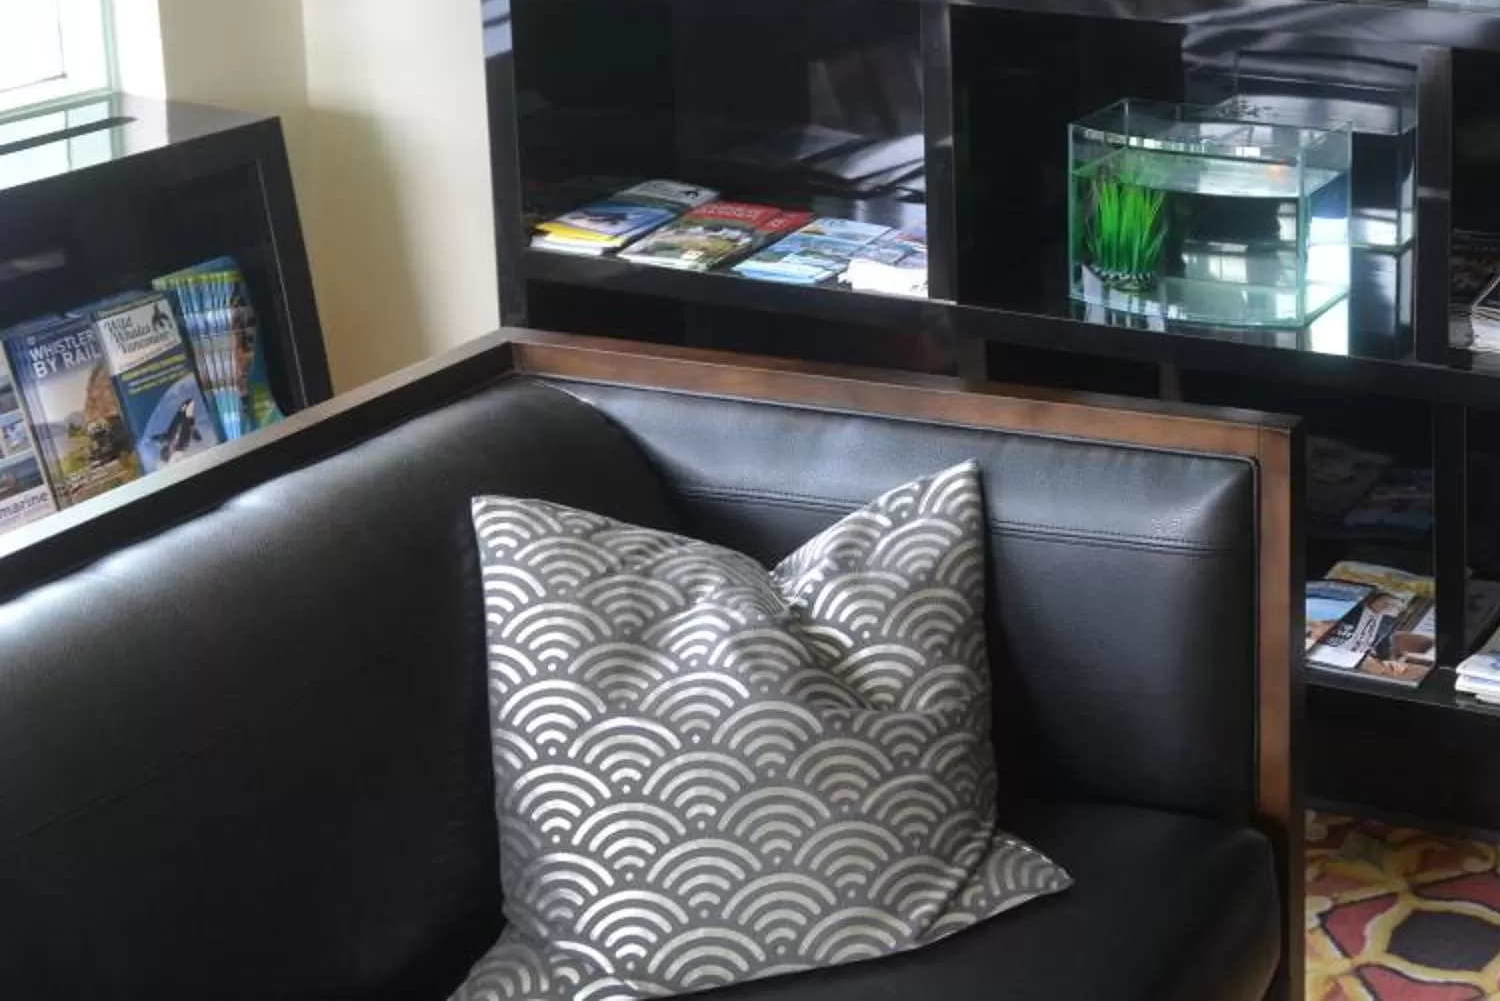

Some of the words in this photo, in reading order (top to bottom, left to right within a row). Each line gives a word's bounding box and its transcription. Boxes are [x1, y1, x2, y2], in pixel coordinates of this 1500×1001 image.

[29, 329, 93, 361] WHISTLER
[33, 356, 57, 378] BY
[62, 343, 103, 368] RAIL
